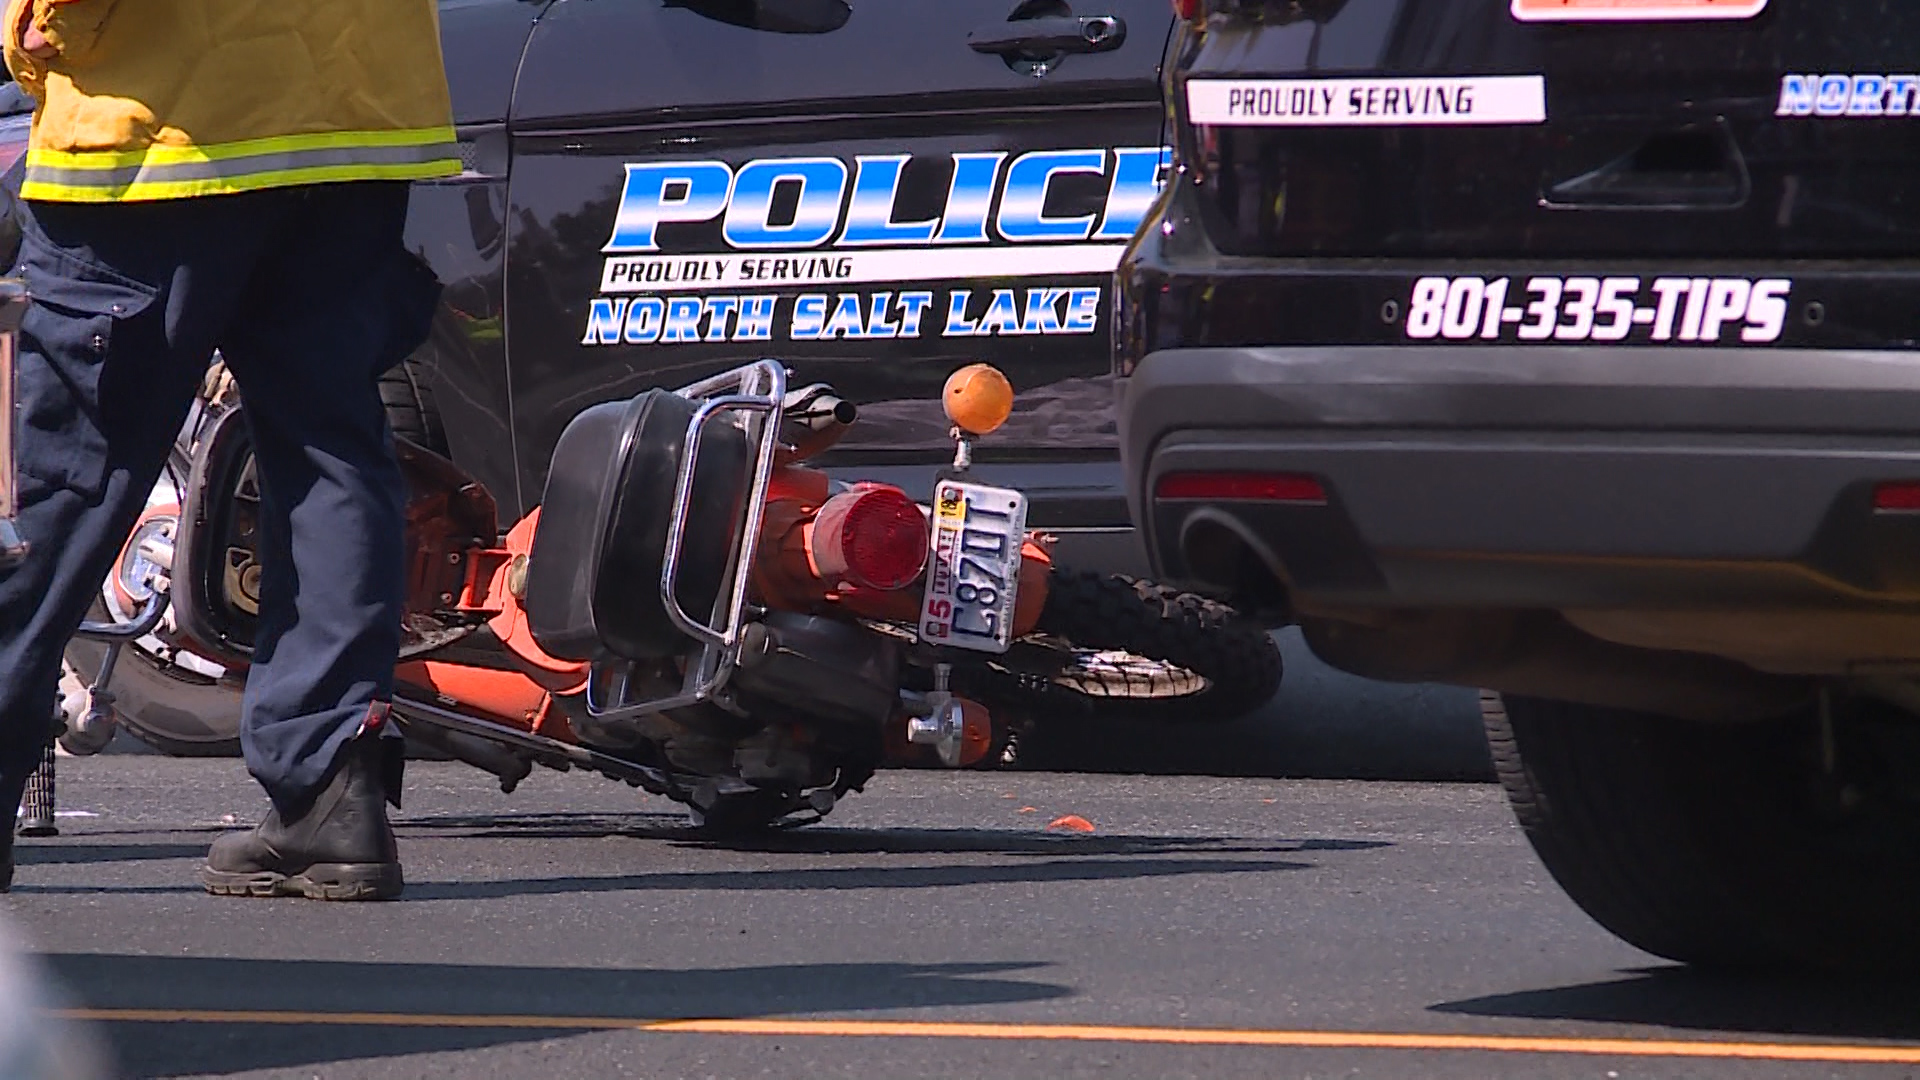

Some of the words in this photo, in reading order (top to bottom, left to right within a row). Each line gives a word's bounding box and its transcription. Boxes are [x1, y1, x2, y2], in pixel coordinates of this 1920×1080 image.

[1228, 87, 1337, 116] PROUDLY
[1348, 85, 1475, 115] SERVING
[1774, 74, 1920, 116] NORT
[609, 257, 731, 284] PROUDLY
[738, 256, 853, 281] SERVING
[580, 295, 779, 345] NORTH
[790, 290, 933, 339] SALT
[941, 286, 1102, 336] LAKE
[1406, 276, 1792, 342] 801-335-TIPS
[928, 598, 952, 618] 5
